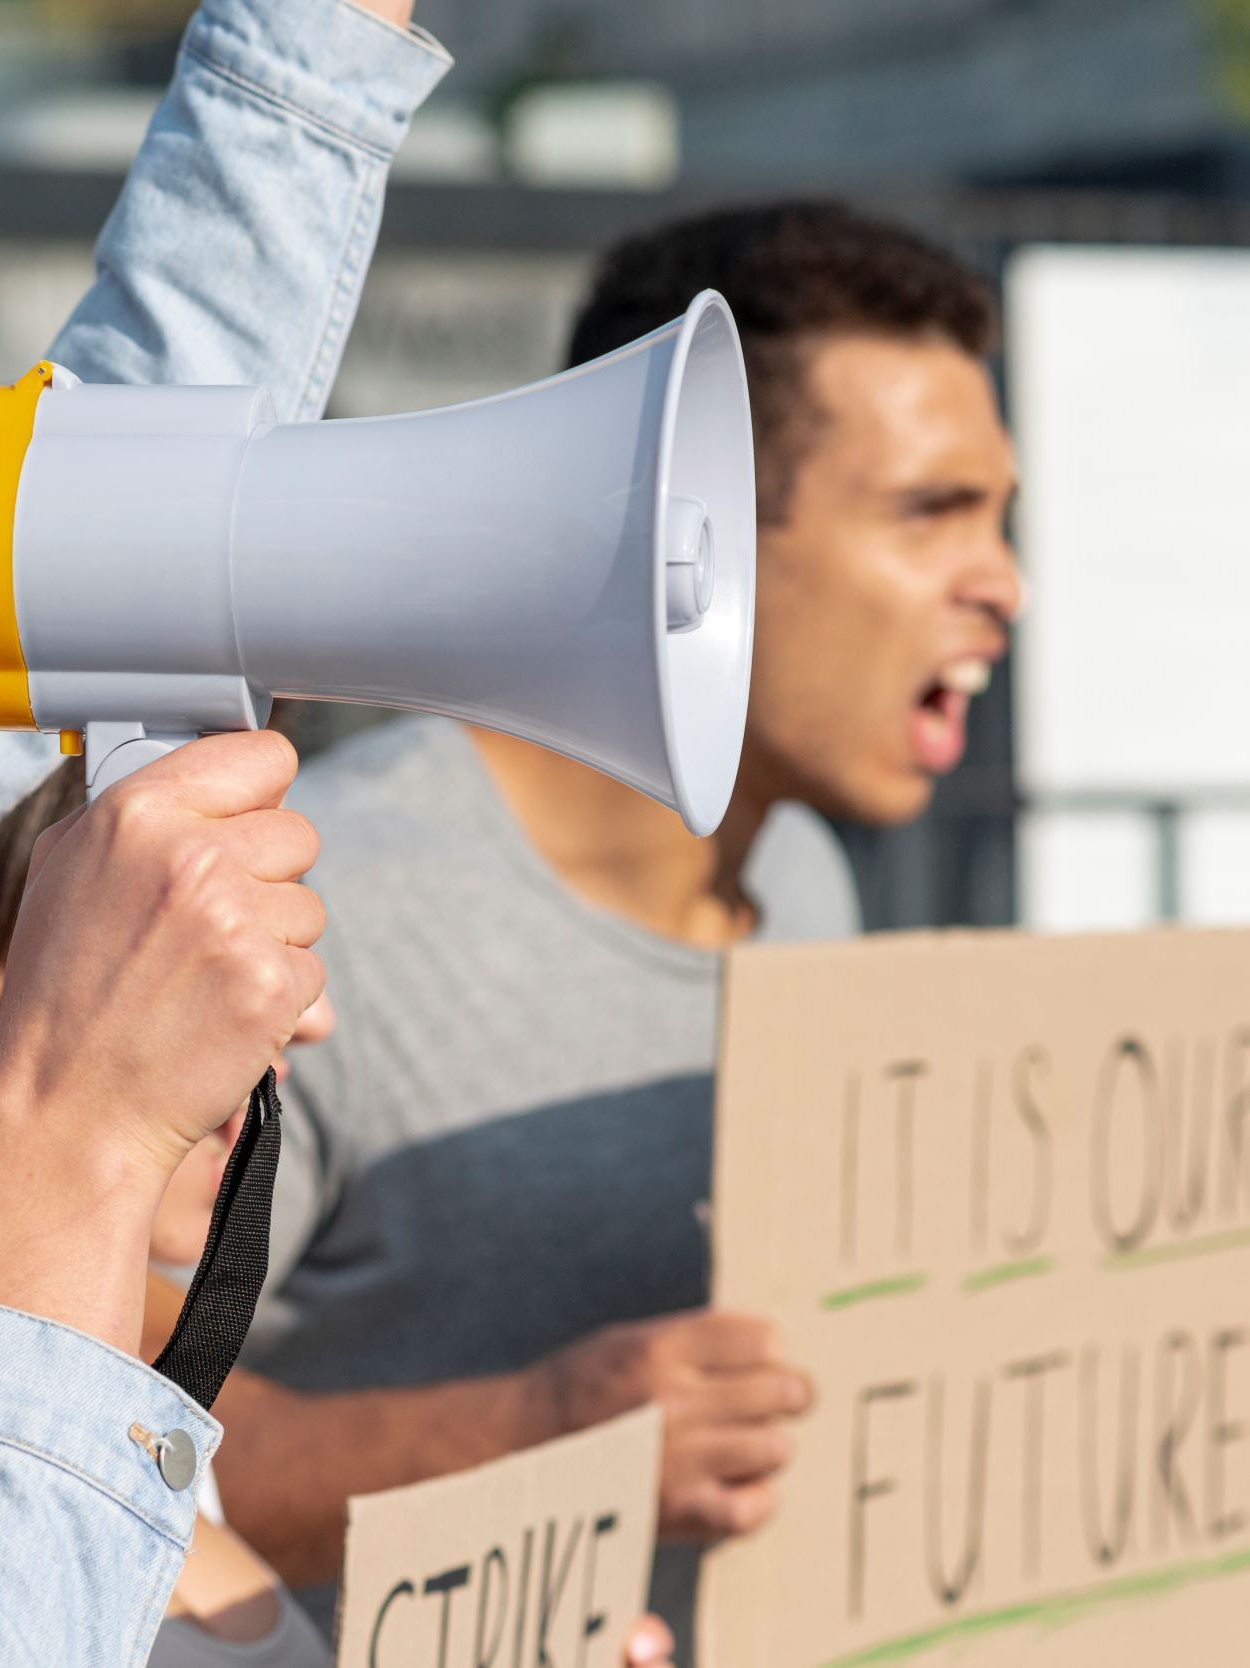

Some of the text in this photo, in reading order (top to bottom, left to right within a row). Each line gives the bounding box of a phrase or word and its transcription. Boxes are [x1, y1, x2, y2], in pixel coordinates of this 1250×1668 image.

[838, 1024, 1250, 1270] IT IS OUR
[847, 1324, 1250, 1626] FUTURE
